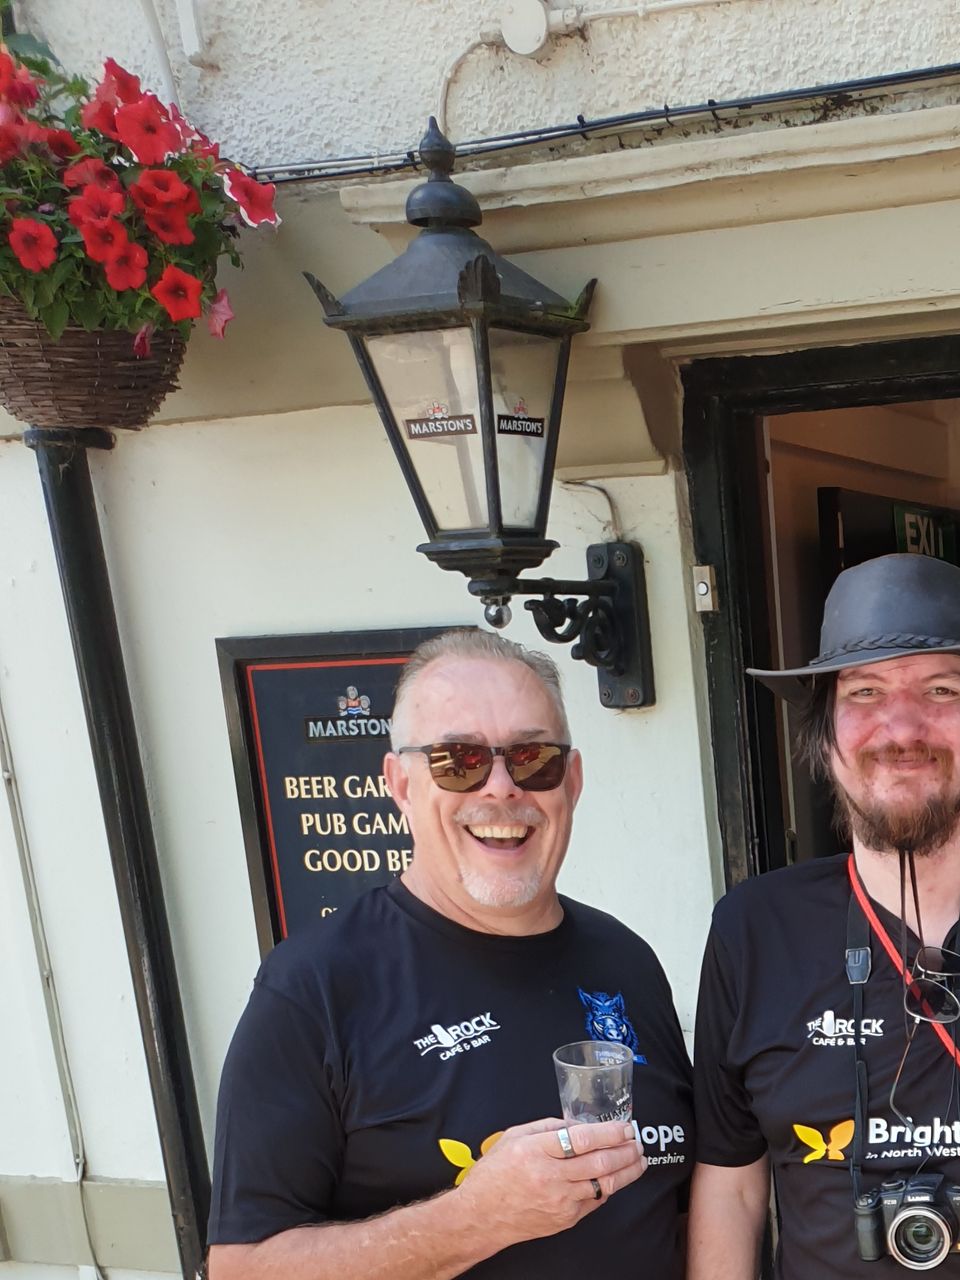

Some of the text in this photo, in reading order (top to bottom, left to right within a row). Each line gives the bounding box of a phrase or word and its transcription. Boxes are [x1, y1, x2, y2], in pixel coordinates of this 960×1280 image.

[411, 419, 473, 435] MARSTON'S
[500, 419, 543, 433] MARSTON'S
[308, 719, 392, 738] MARSTON
[285, 775, 393, 799] BEER GAR
[301, 812, 410, 835] PUB GAM
[304, 849, 413, 872] GOOD BE
[413, 1012, 498, 1050] THE ROCK
[470, 1035, 491, 1048] BAR
[837, 1037, 845, 1046] &
[647, 1152, 685, 1166] tershire
[881, 1147, 922, 1159] North
